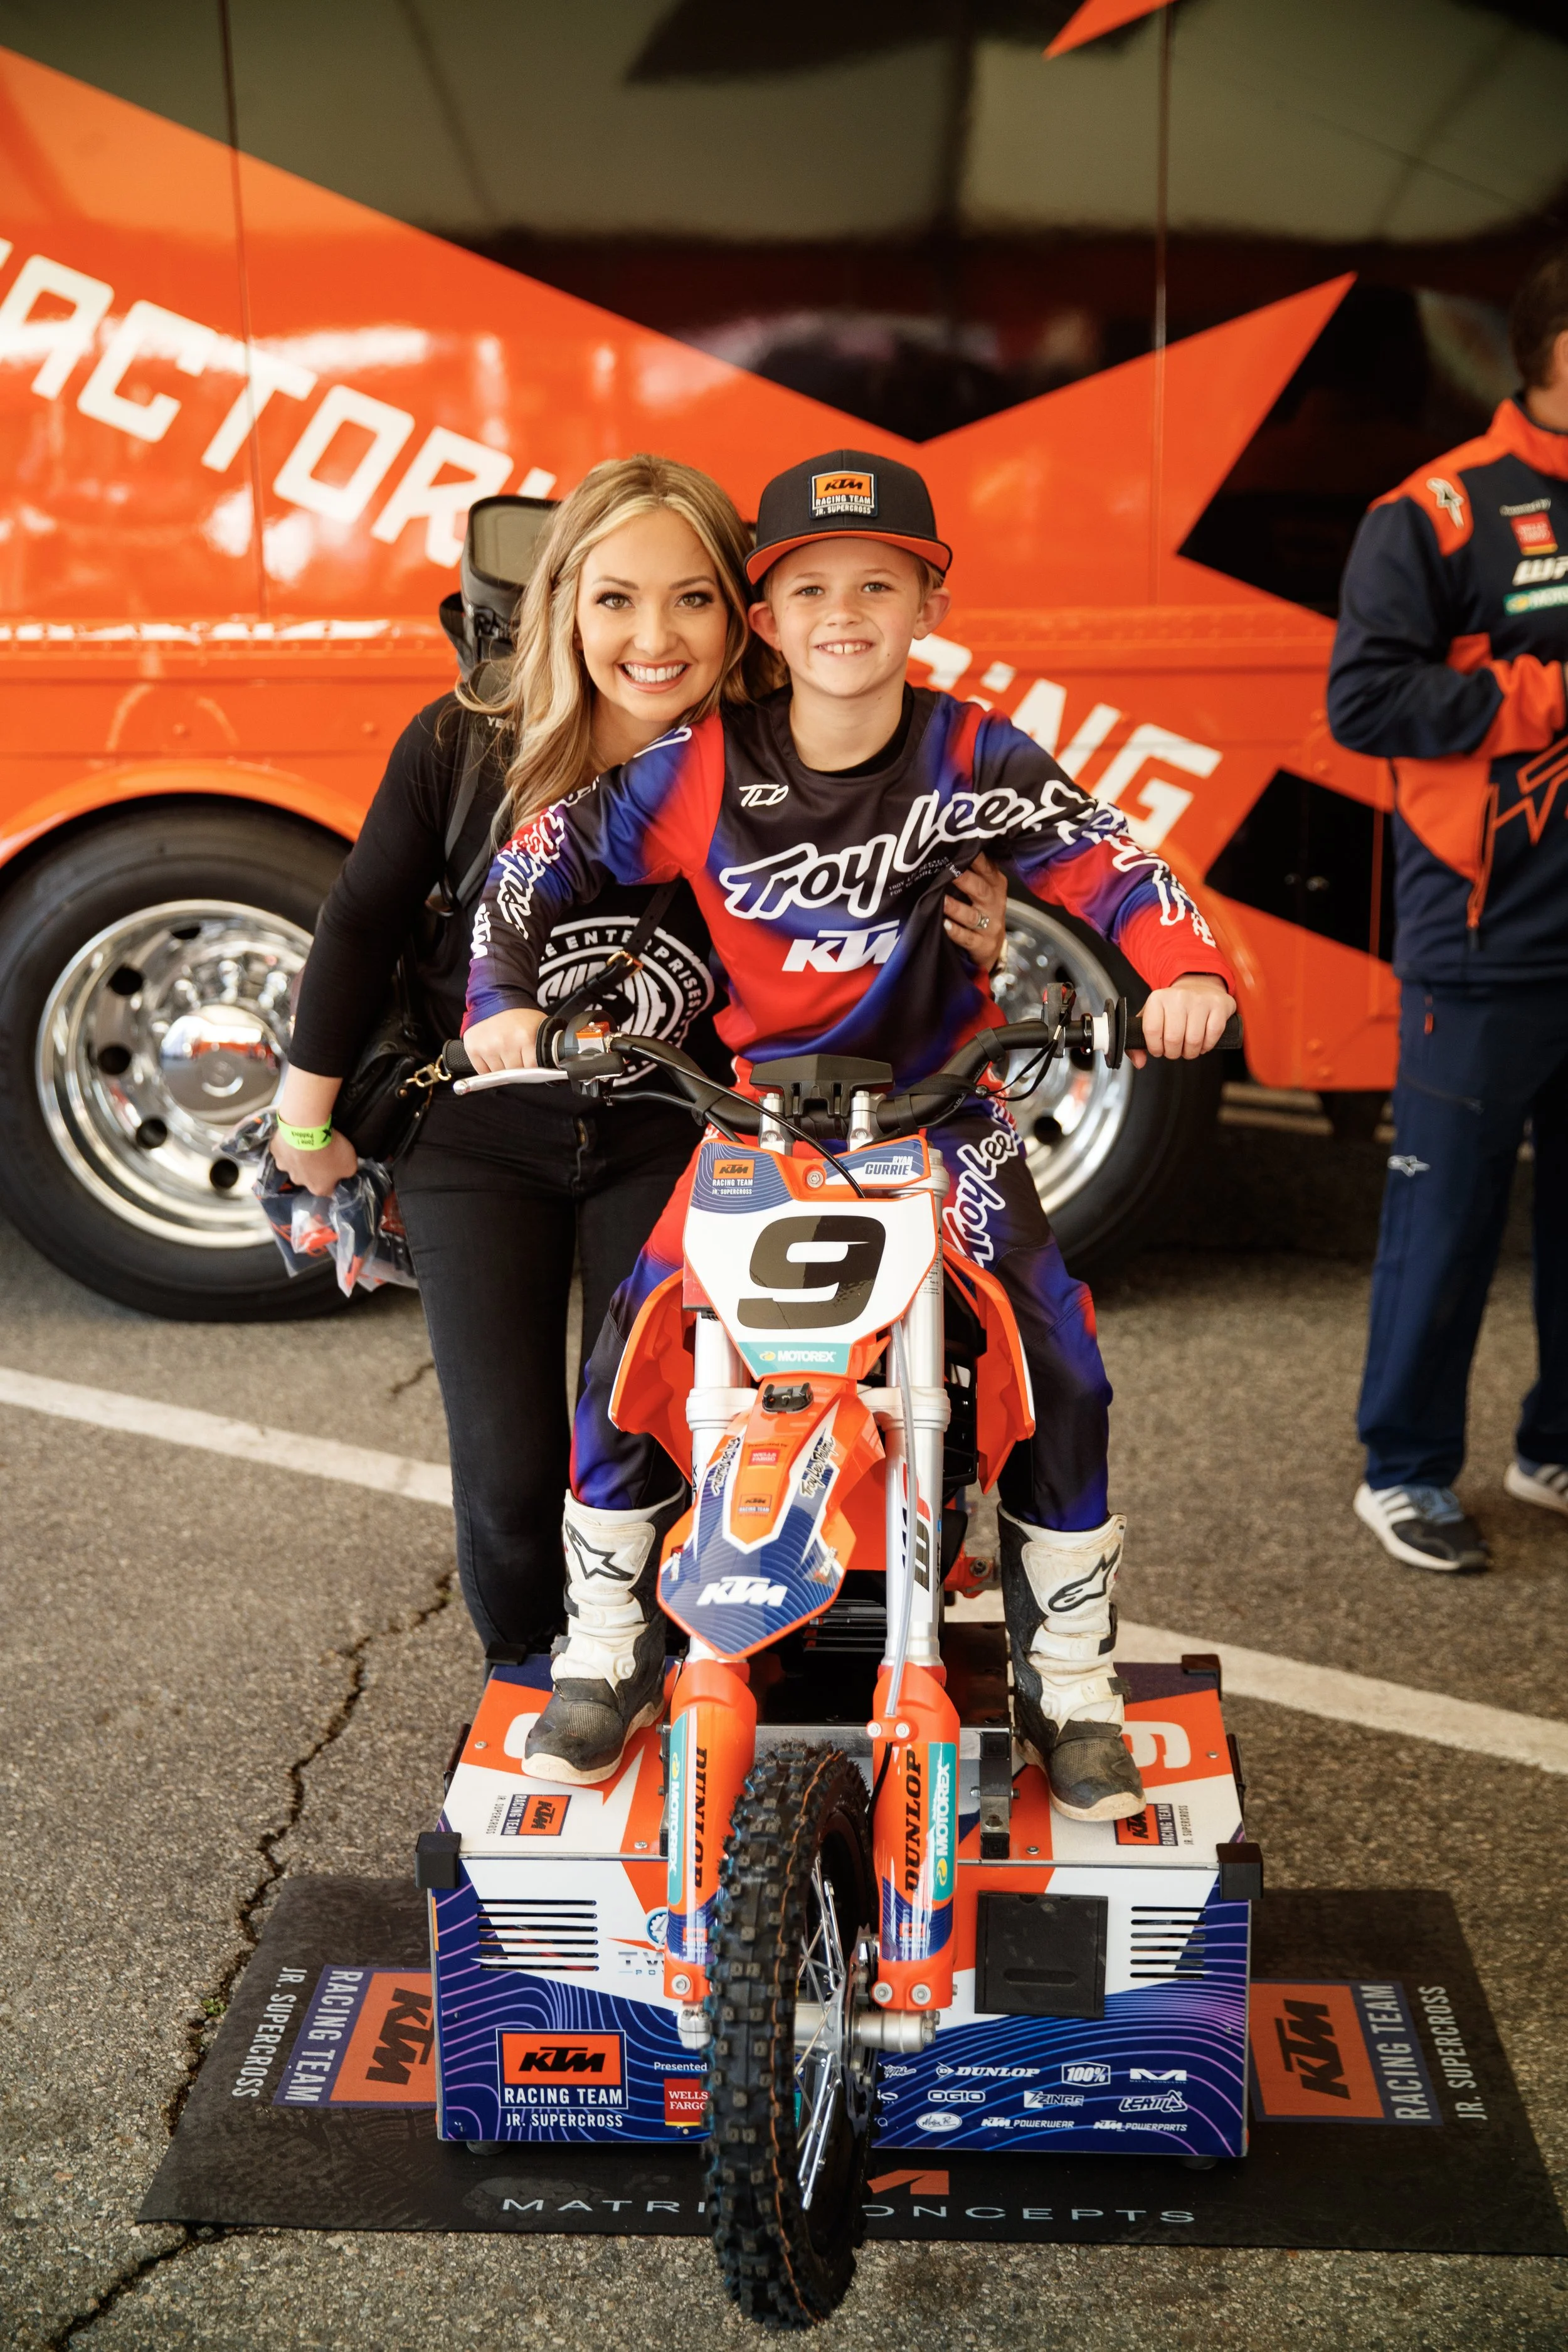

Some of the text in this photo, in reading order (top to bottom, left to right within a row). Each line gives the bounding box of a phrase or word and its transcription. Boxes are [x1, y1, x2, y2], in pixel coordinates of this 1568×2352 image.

[0, 236, 557, 568] ACTOR
[824, 478, 863, 491] KTM
[815, 495, 871, 506] RACING TEAM
[815, 504, 872, 516] JR. SUPERCROSS
[719, 1164, 749, 1174] KTM
[865, 1164, 910, 1175] CURRIE
[737, 1215, 886, 1330] 9
[777, 1350, 835, 1363] MOTOREX
[696, 1576, 788, 1607] KTM
[504, 1794, 527, 1835] RACING TEAM
[531, 1800, 556, 1830] KTM
[694, 1747, 707, 1888] DUNLOP
[904, 1750, 924, 1892] DUNLOP
[935, 1762, 951, 1857] MOTOREX
[669, 1781, 681, 1877] MOTOREX
[1157, 1804, 1176, 1845] RACING TEAM
[231, 1966, 308, 2097] JR. SUPERCROSS
[285, 1970, 364, 2101] RACING TEAM
[365, 1987, 435, 2085] KTM
[518, 2046, 606, 2073] KTM
[1274, 1999, 1352, 2100] KTM
[1359, 1985, 1432, 2120] RACING TEAM
[1417, 1986, 1488, 2121] JR. SUPERCROSS
[654, 2061, 707, 2072] Presented
[954, 2066, 1041, 2077] DUNLOP
[1067, 2067, 1106, 2082] 100%
[504, 2087, 623, 2105] RACING TEAM
[668, 2090, 709, 2100] WELLS
[669, 2101, 707, 2110] FARGO
[928, 2090, 985, 2102] OGIO
[506, 2113, 623, 2127] JR. SUPERCROSS
[502, 2198, 1195, 2223] MATRI ONCEPTS
